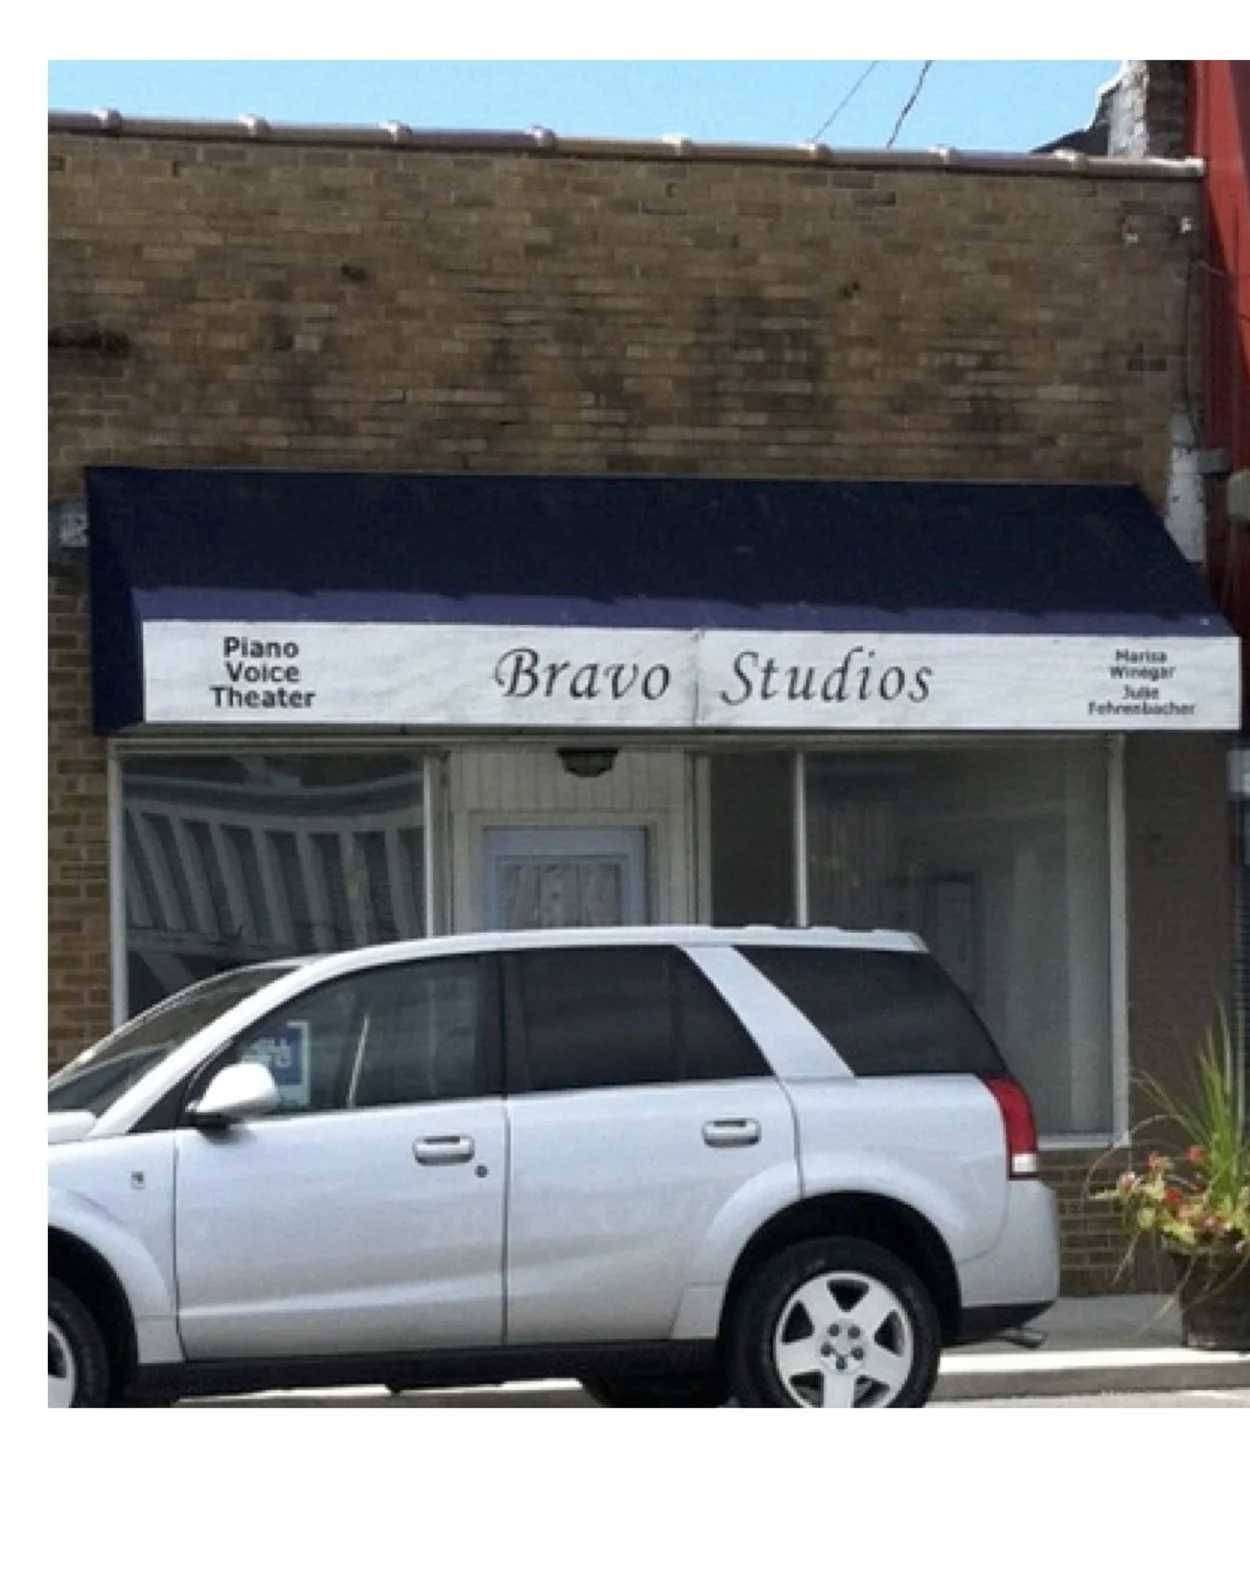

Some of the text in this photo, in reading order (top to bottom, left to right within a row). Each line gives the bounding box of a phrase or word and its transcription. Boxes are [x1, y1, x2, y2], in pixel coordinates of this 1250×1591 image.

[223, 636, 299, 658] Piano
[224, 661, 299, 682] Voice
[494, 646, 934, 705] Bravo Studios
[209, 685, 317, 708] Theater
